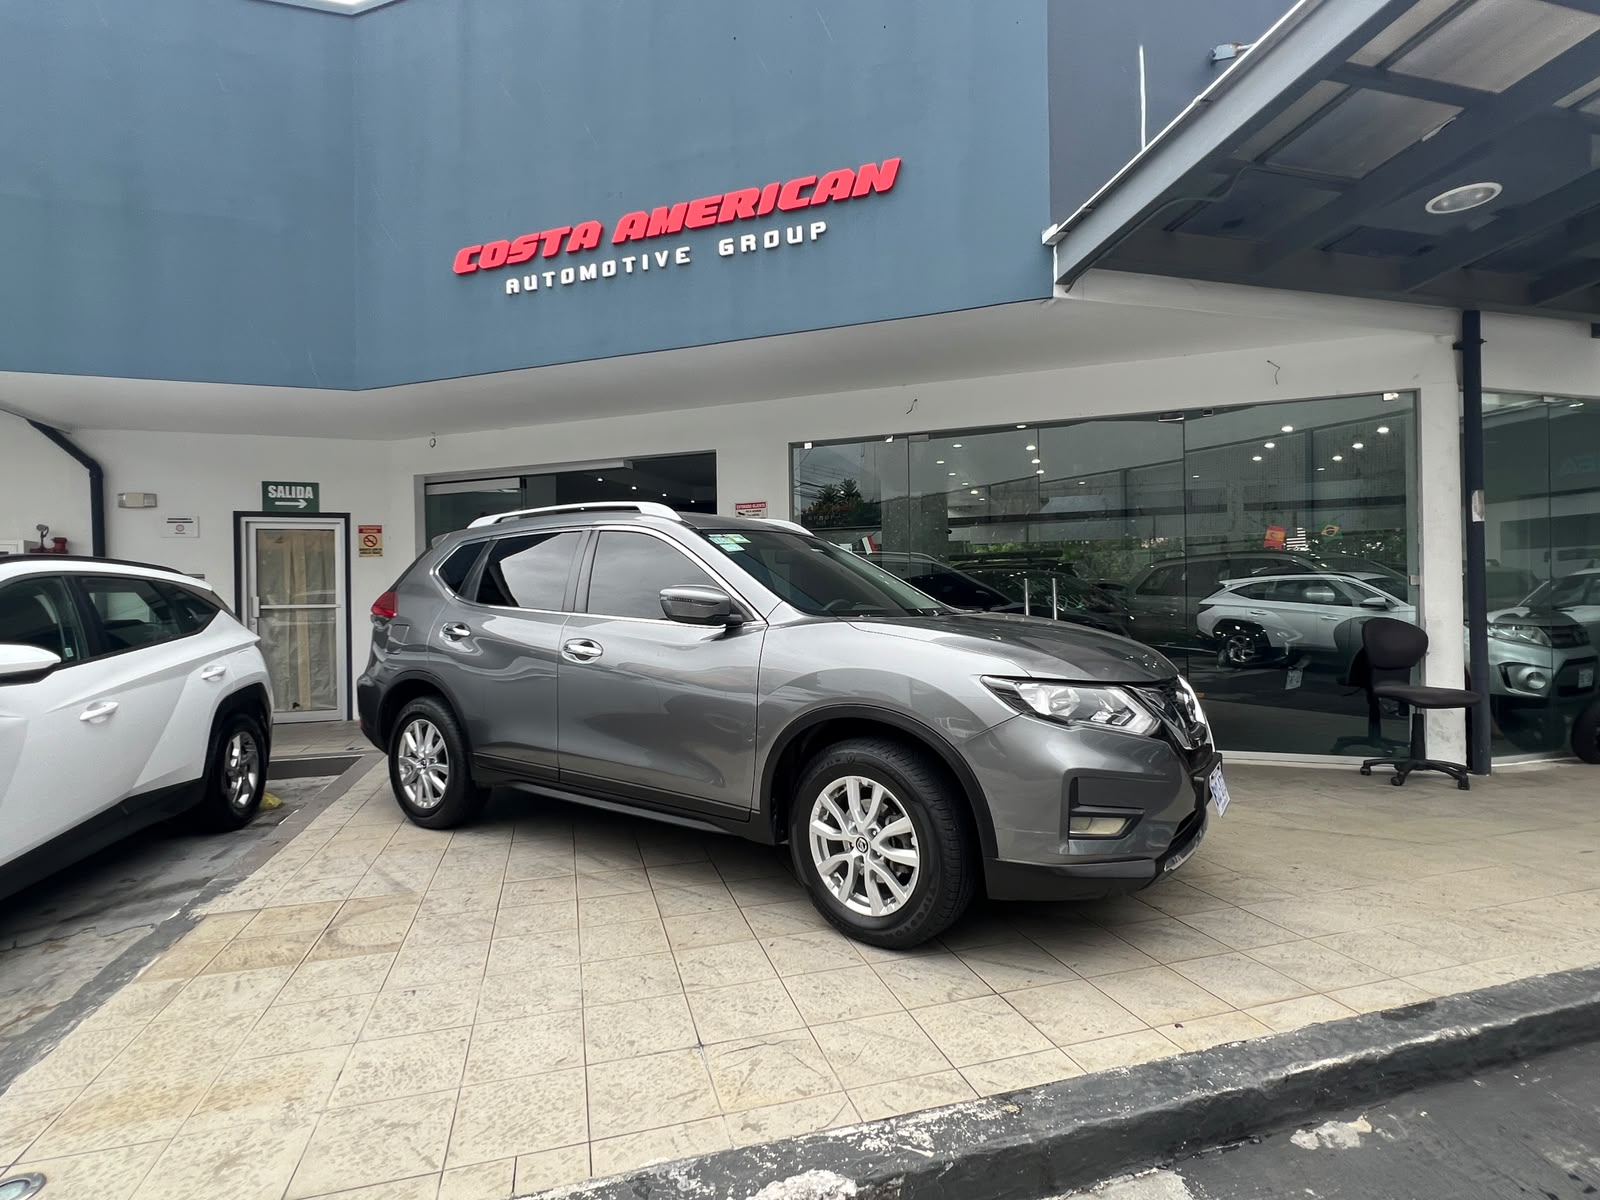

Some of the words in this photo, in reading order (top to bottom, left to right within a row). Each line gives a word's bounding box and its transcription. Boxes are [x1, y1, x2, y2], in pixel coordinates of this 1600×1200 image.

[453, 220, 603, 275] COSTA
[611, 157, 901, 245] AMERICAN
[505, 246, 691, 295] AUTOMOTIVE
[718, 220, 827, 256] GROUP
[268, 484, 313, 499] SALIDA
